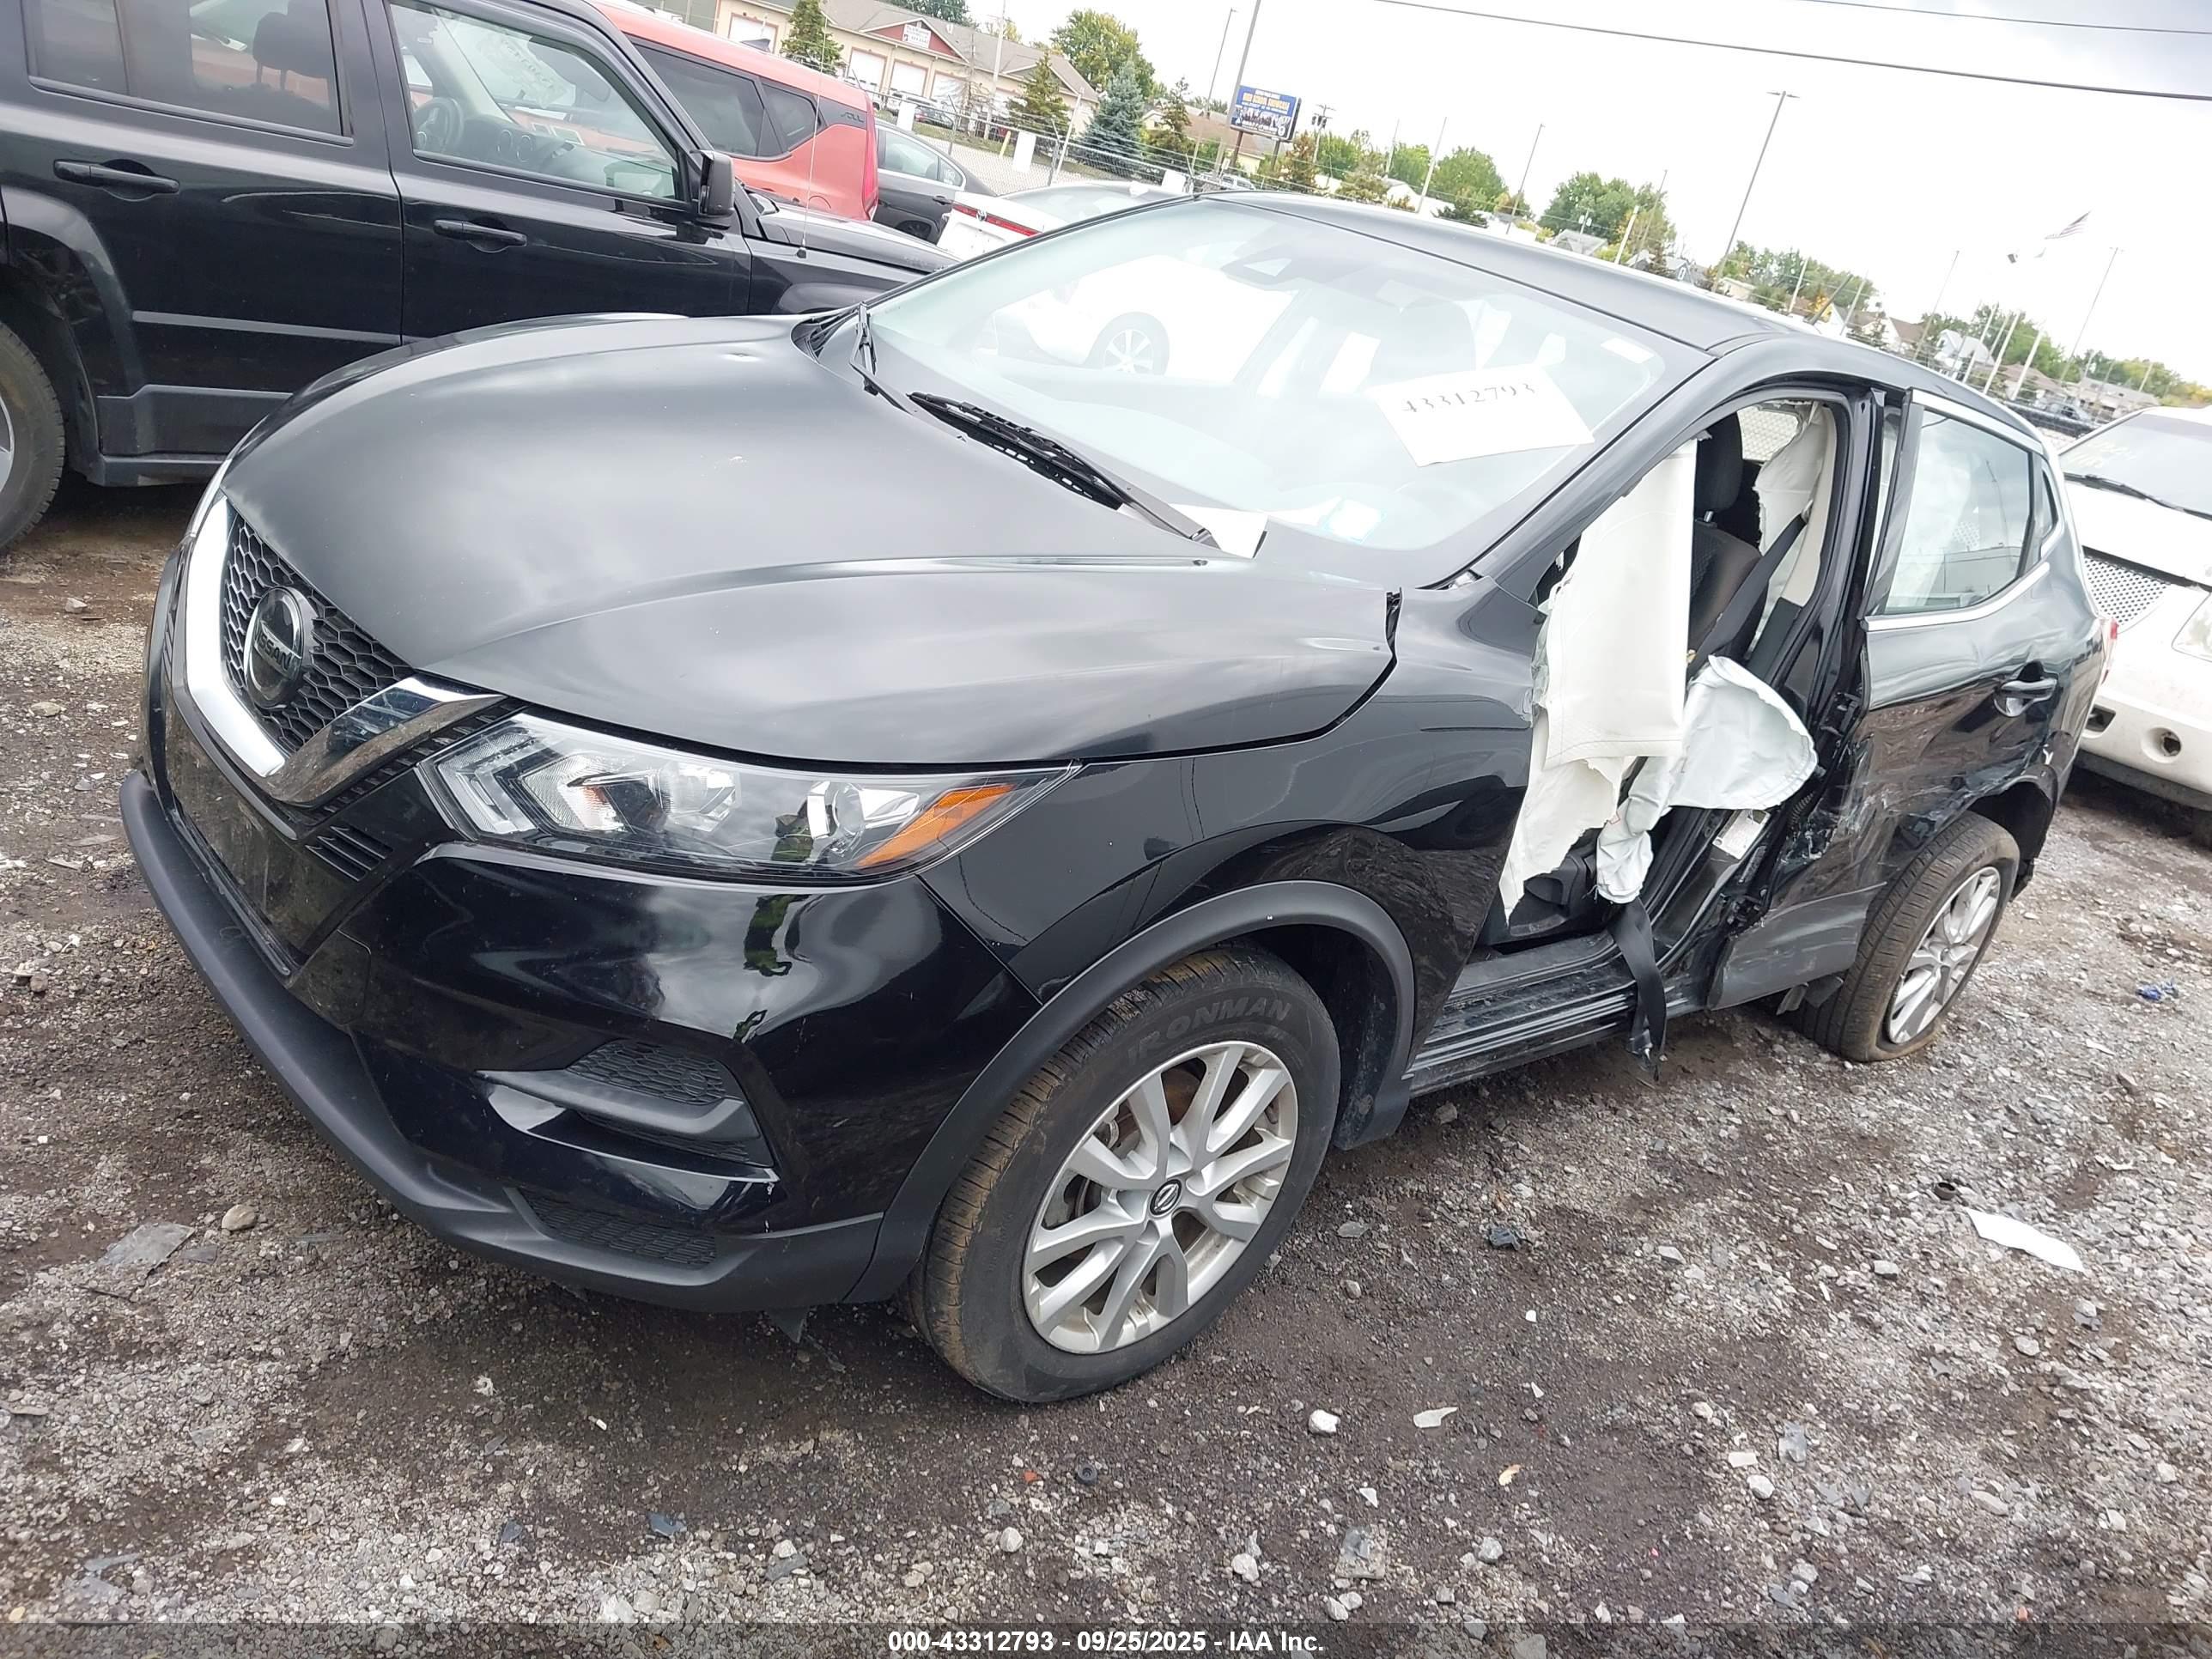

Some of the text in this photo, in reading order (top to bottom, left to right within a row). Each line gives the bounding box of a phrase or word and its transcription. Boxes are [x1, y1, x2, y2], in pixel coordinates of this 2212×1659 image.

[1401, 382, 1537, 413] 43312793
[253, 624, 293, 672] NISSAN
[1127, 997, 1292, 1066] IRONMAN
